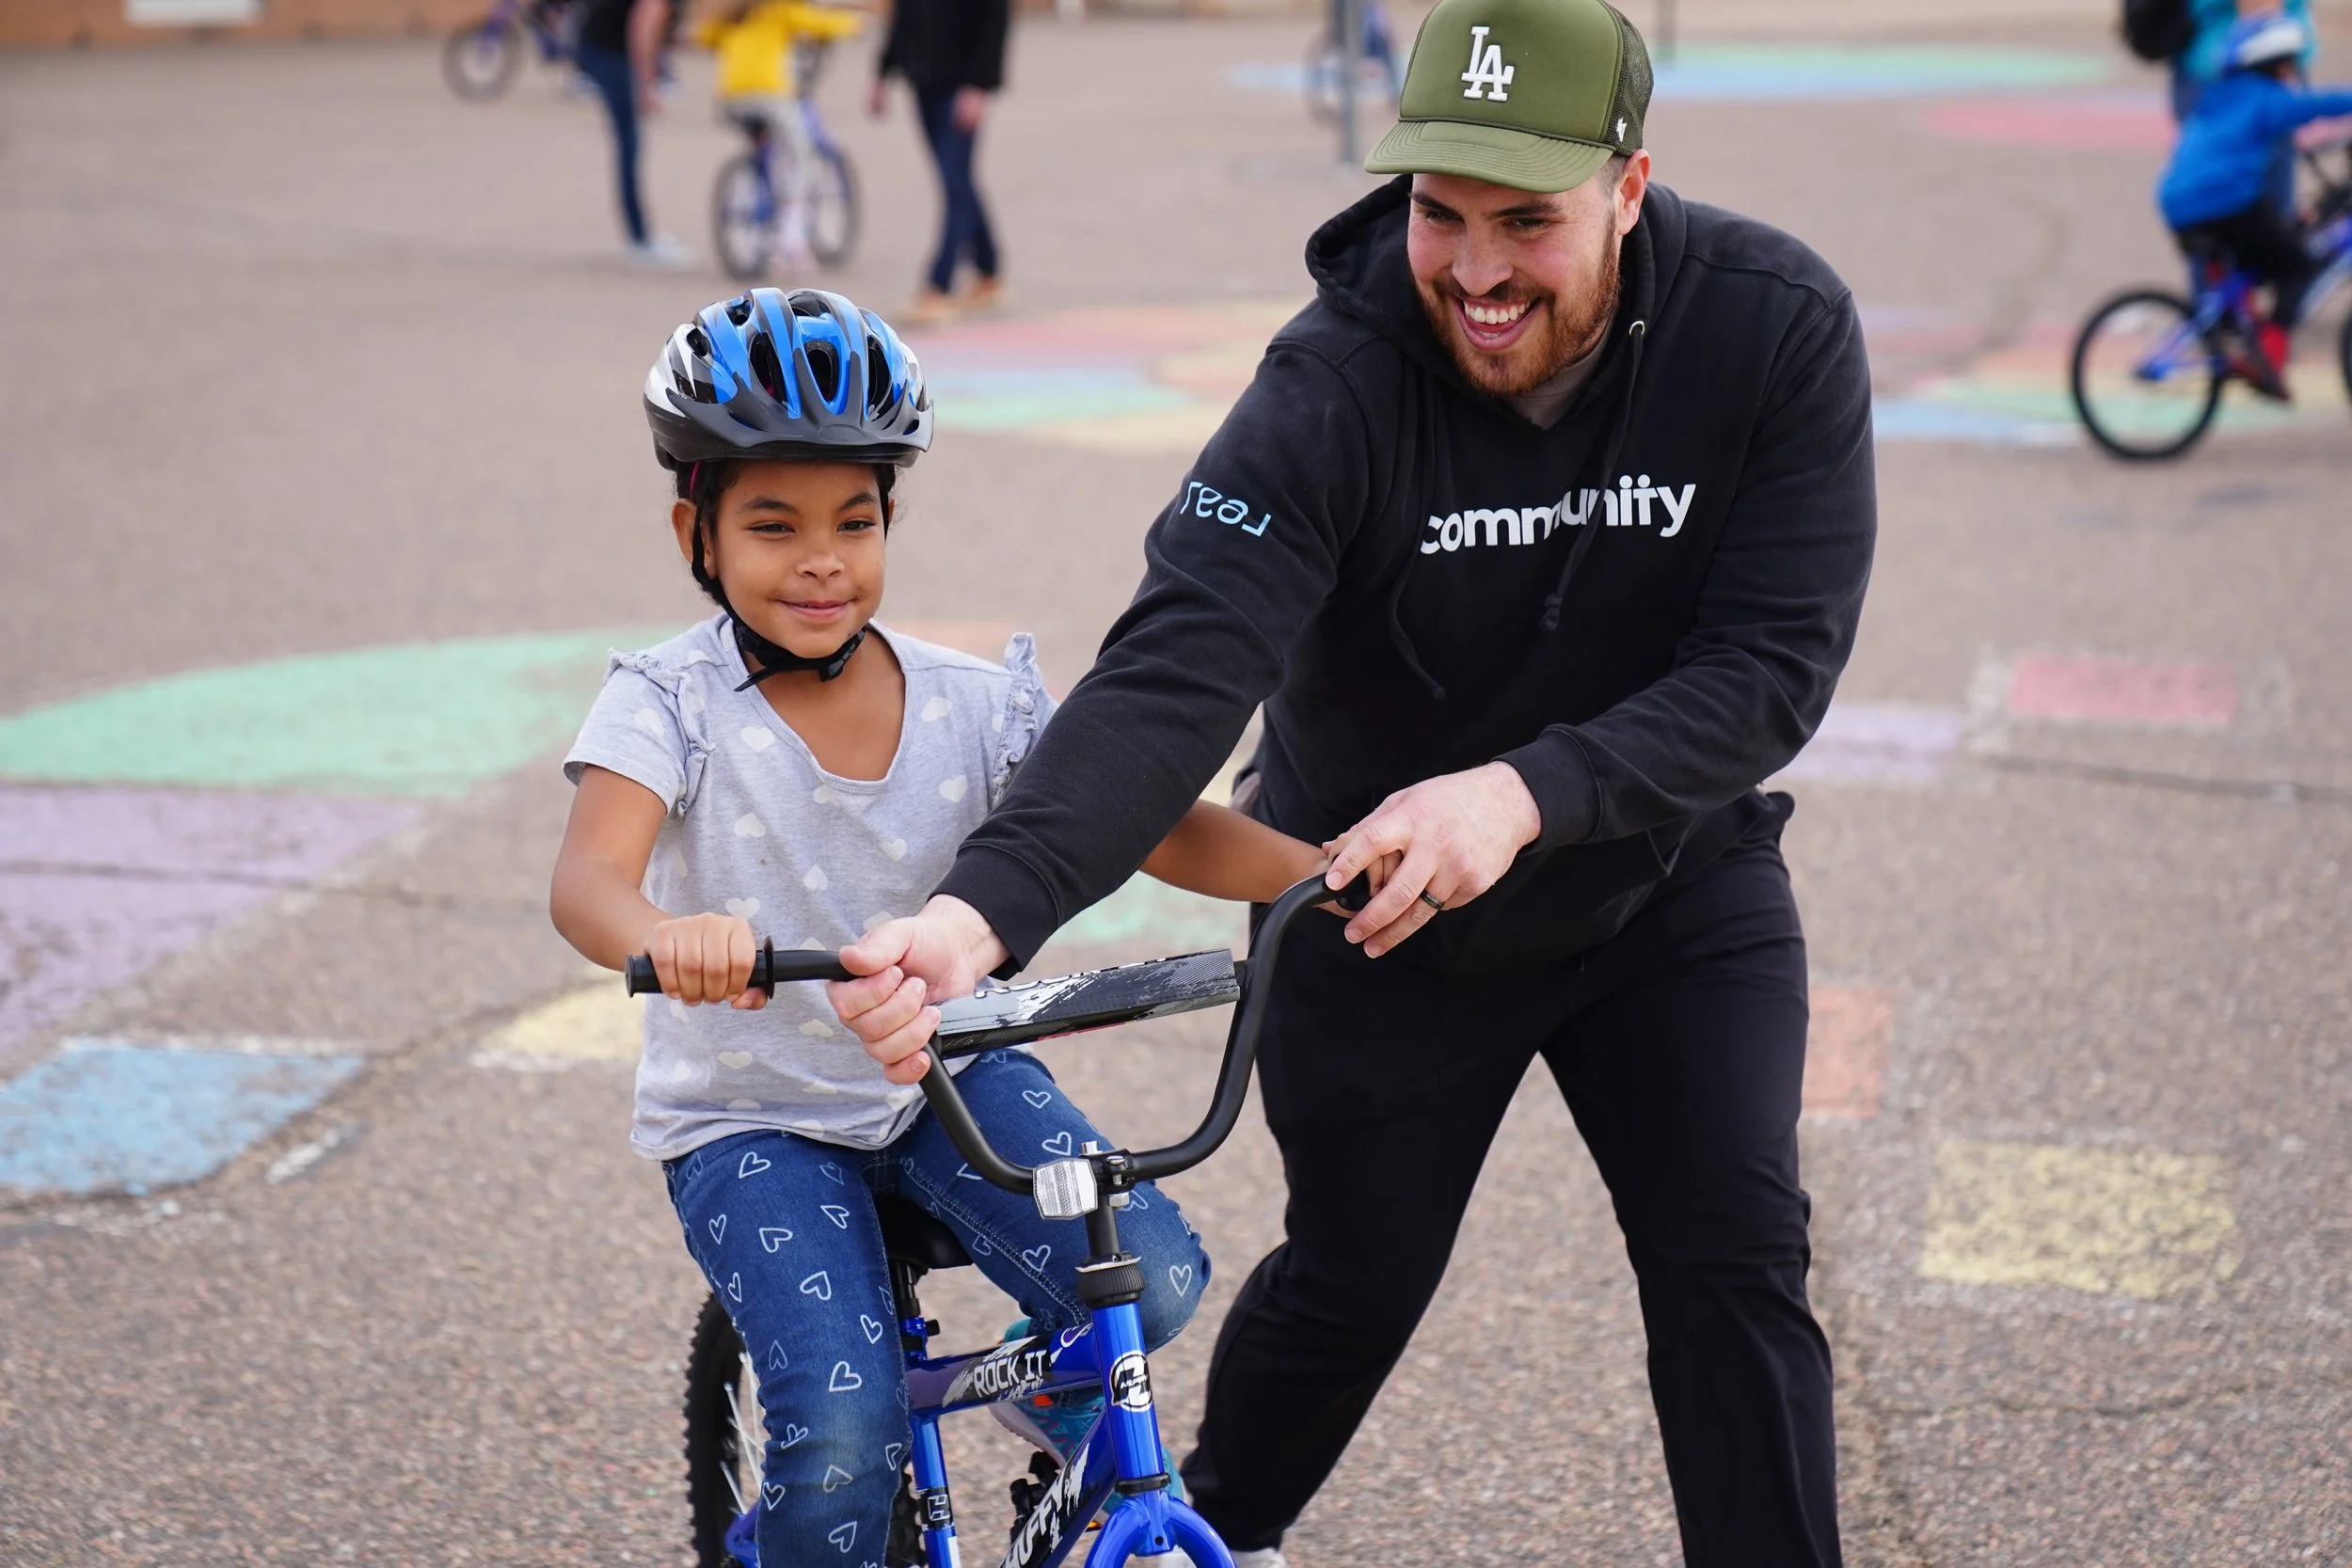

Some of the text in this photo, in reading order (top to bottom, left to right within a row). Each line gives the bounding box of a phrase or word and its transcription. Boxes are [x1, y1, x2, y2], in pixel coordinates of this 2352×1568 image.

[1461, 26, 1515, 102] LA
[1420, 473, 1697, 555] community
[973, 1348, 1048, 1399] ROCK IT
